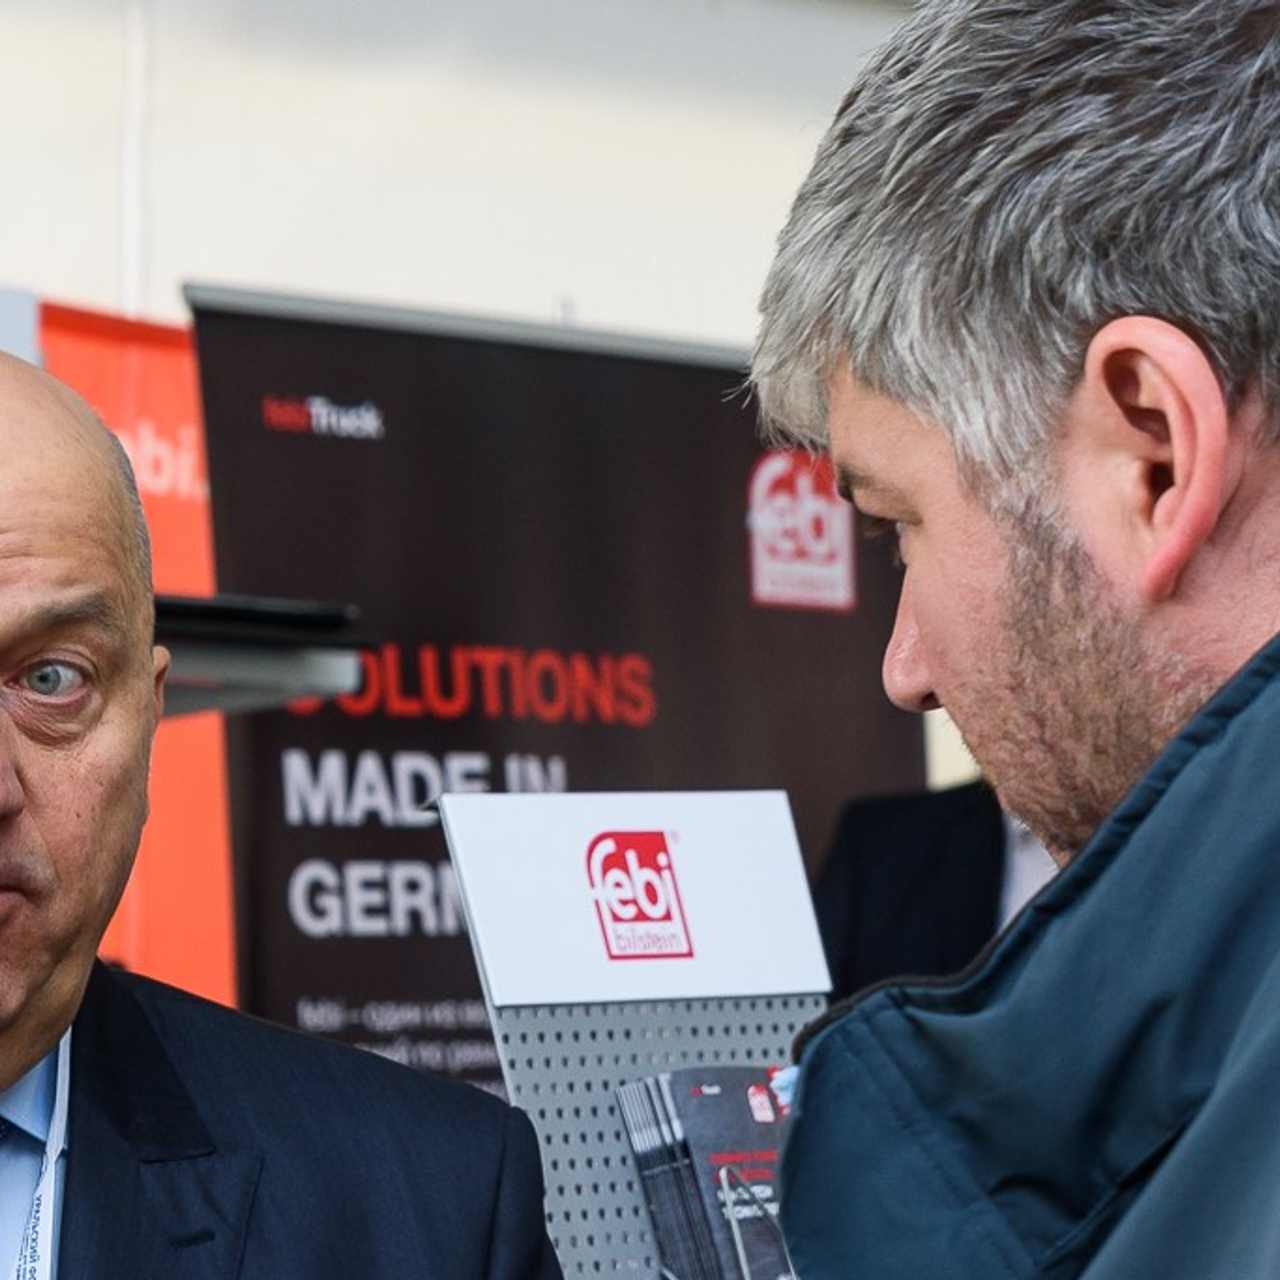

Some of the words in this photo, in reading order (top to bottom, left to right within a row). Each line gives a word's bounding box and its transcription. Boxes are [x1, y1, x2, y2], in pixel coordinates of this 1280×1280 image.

[286, 642, 658, 727] OLUTIONS
[280, 746, 490, 829] MADE
[591, 836, 680, 922] febi
[612, 924, 684, 953] bilstein
